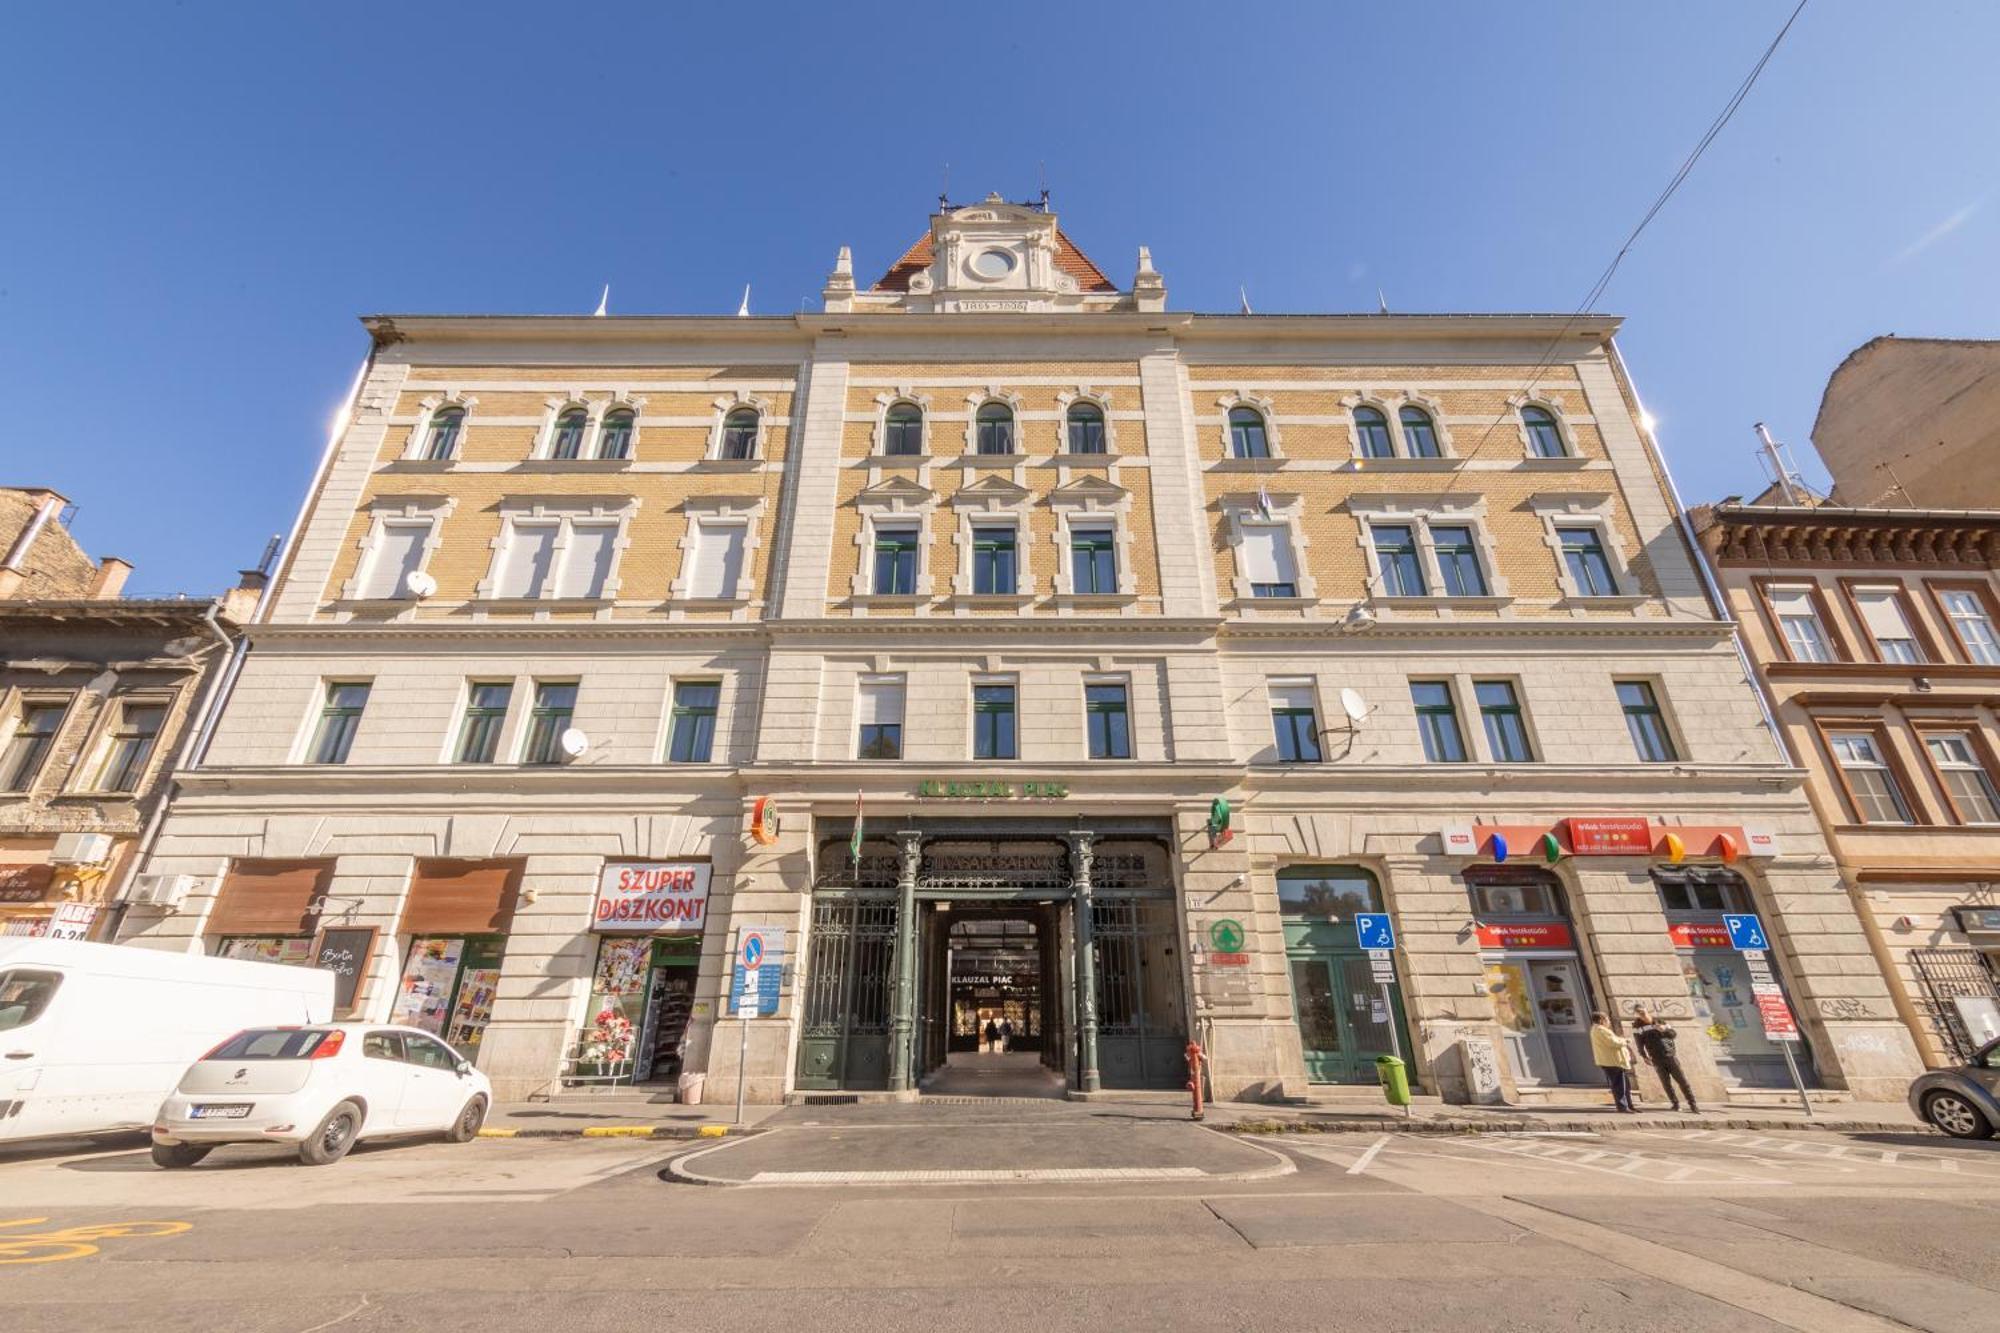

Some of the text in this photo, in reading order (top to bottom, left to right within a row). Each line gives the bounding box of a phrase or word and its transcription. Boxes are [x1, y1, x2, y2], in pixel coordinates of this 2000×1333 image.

[618, 868, 697, 892] SZUPER
[597, 898, 704, 921] DISZKONT
[1360, 918, 1373, 934] P
[1728, 919, 1742, 935] P
[992, 975, 1013, 984] PIAC
